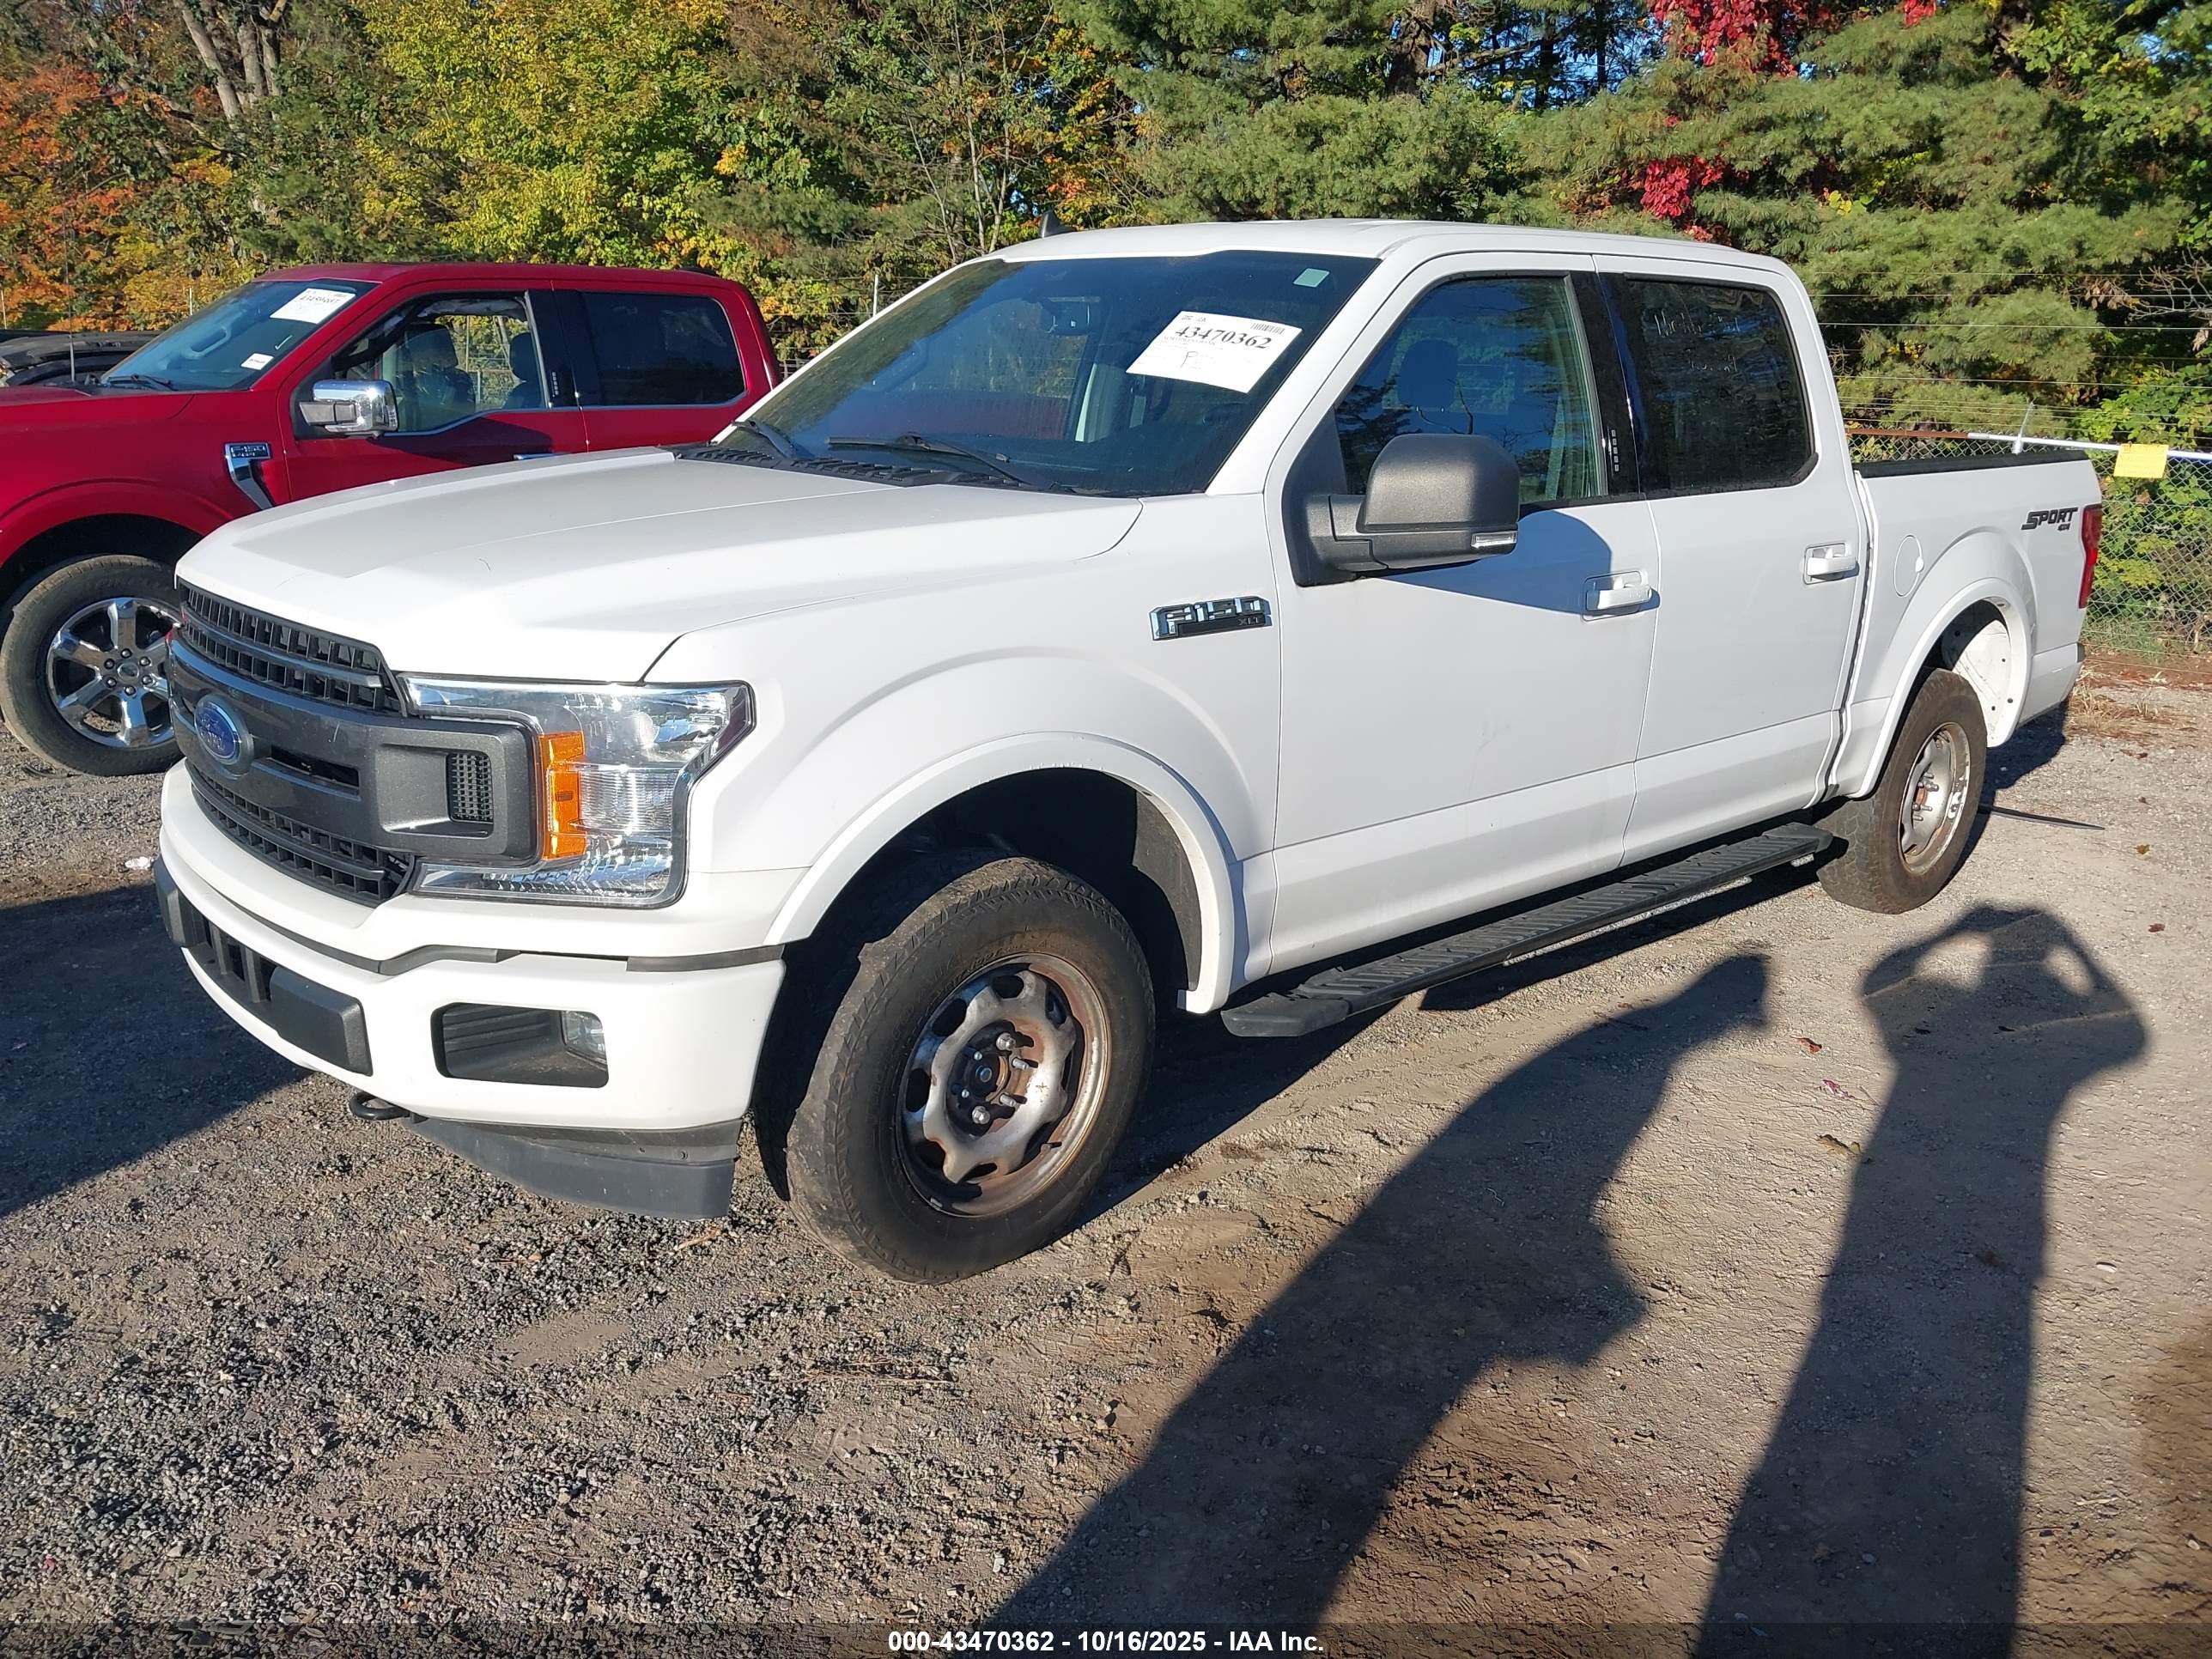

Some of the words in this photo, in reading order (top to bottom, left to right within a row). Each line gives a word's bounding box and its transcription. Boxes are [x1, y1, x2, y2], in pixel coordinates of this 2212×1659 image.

[1175, 325, 1272, 349] 43470362
[2021, 507, 2079, 531] SPORT
[1238, 617, 1261, 626] XLT
